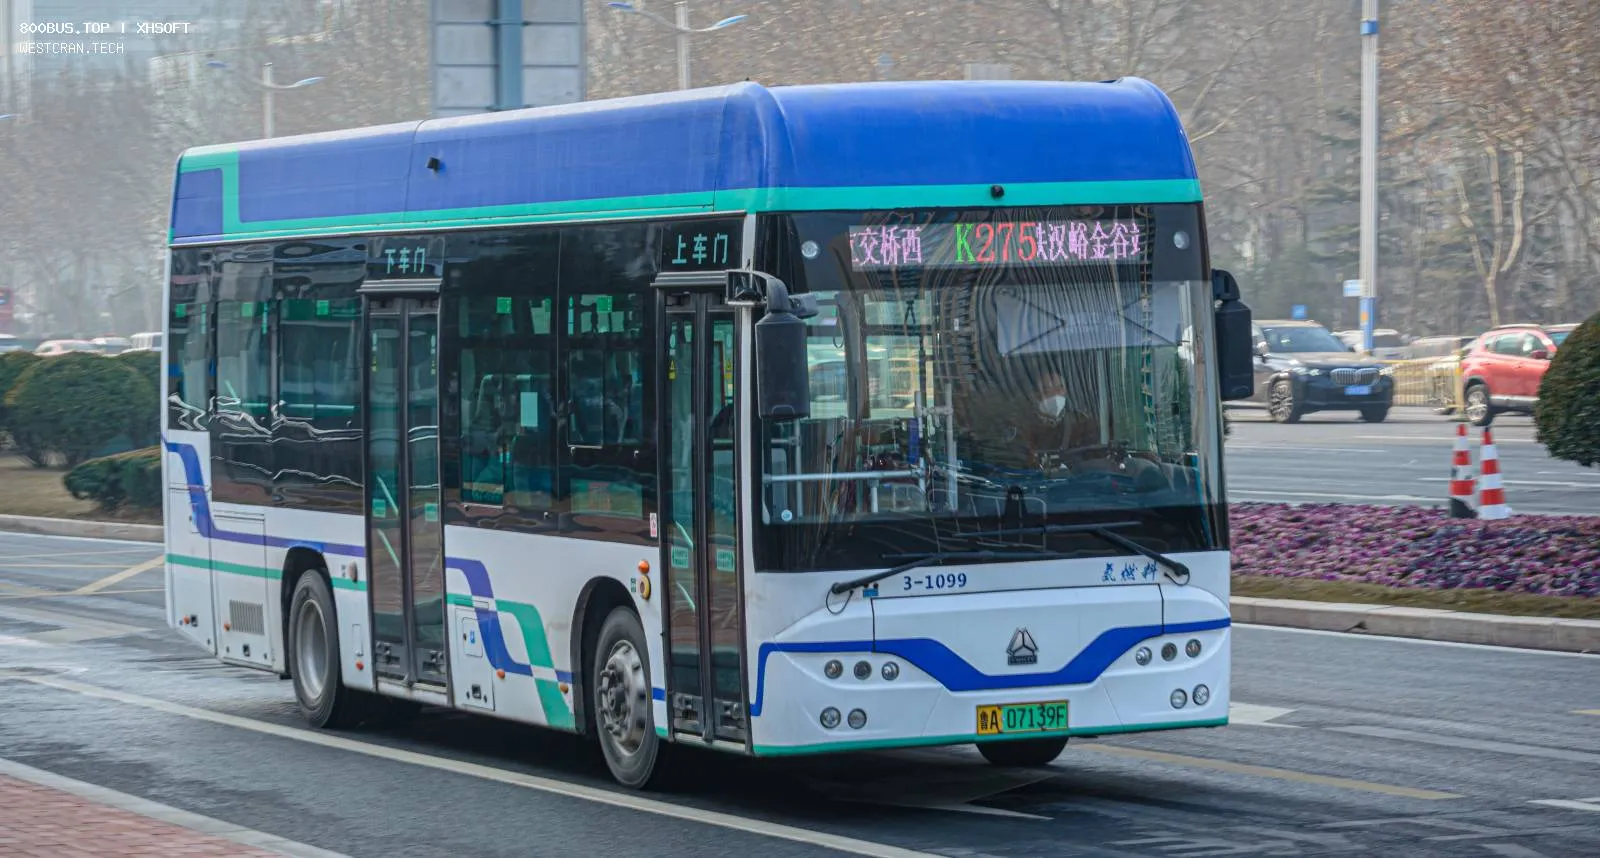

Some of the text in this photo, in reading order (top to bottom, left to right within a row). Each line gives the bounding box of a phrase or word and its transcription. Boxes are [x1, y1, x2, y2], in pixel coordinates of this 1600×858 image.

[671, 232, 728, 265] 上车门
[954, 222, 1037, 264] K275
[384, 246, 426, 274] 下车门
[903, 572, 967, 591] 3-1099
[1006, 705, 1065, 729] 07139F
